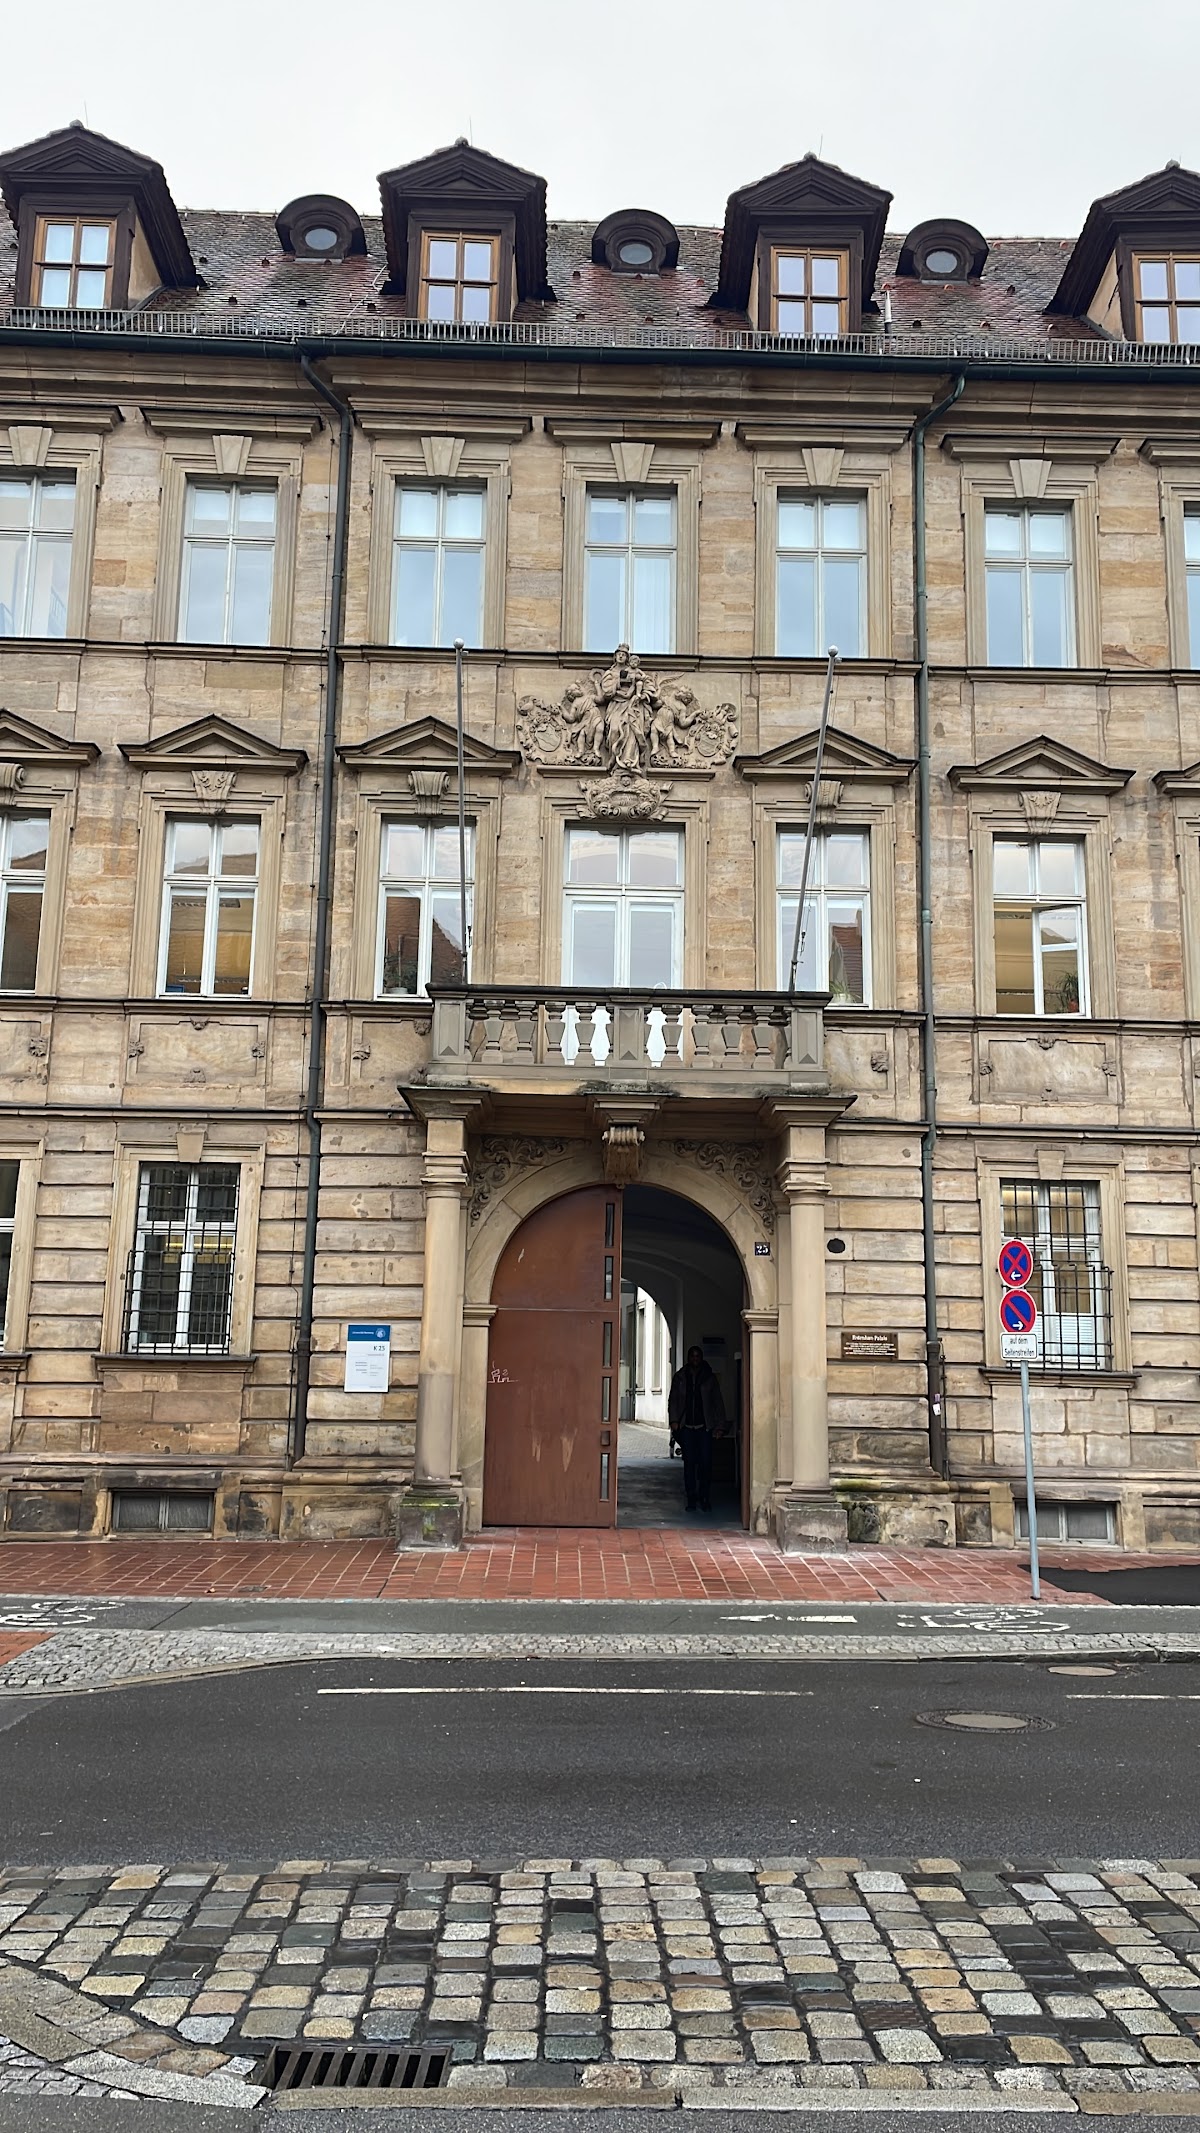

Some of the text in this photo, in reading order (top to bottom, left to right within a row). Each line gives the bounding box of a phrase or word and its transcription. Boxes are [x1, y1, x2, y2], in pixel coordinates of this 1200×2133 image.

[756, 1244, 768, 1253] 25
[1009, 1335, 1029, 1344] auf dem
[1004, 1348, 1034, 1356] Seitenstreifen
